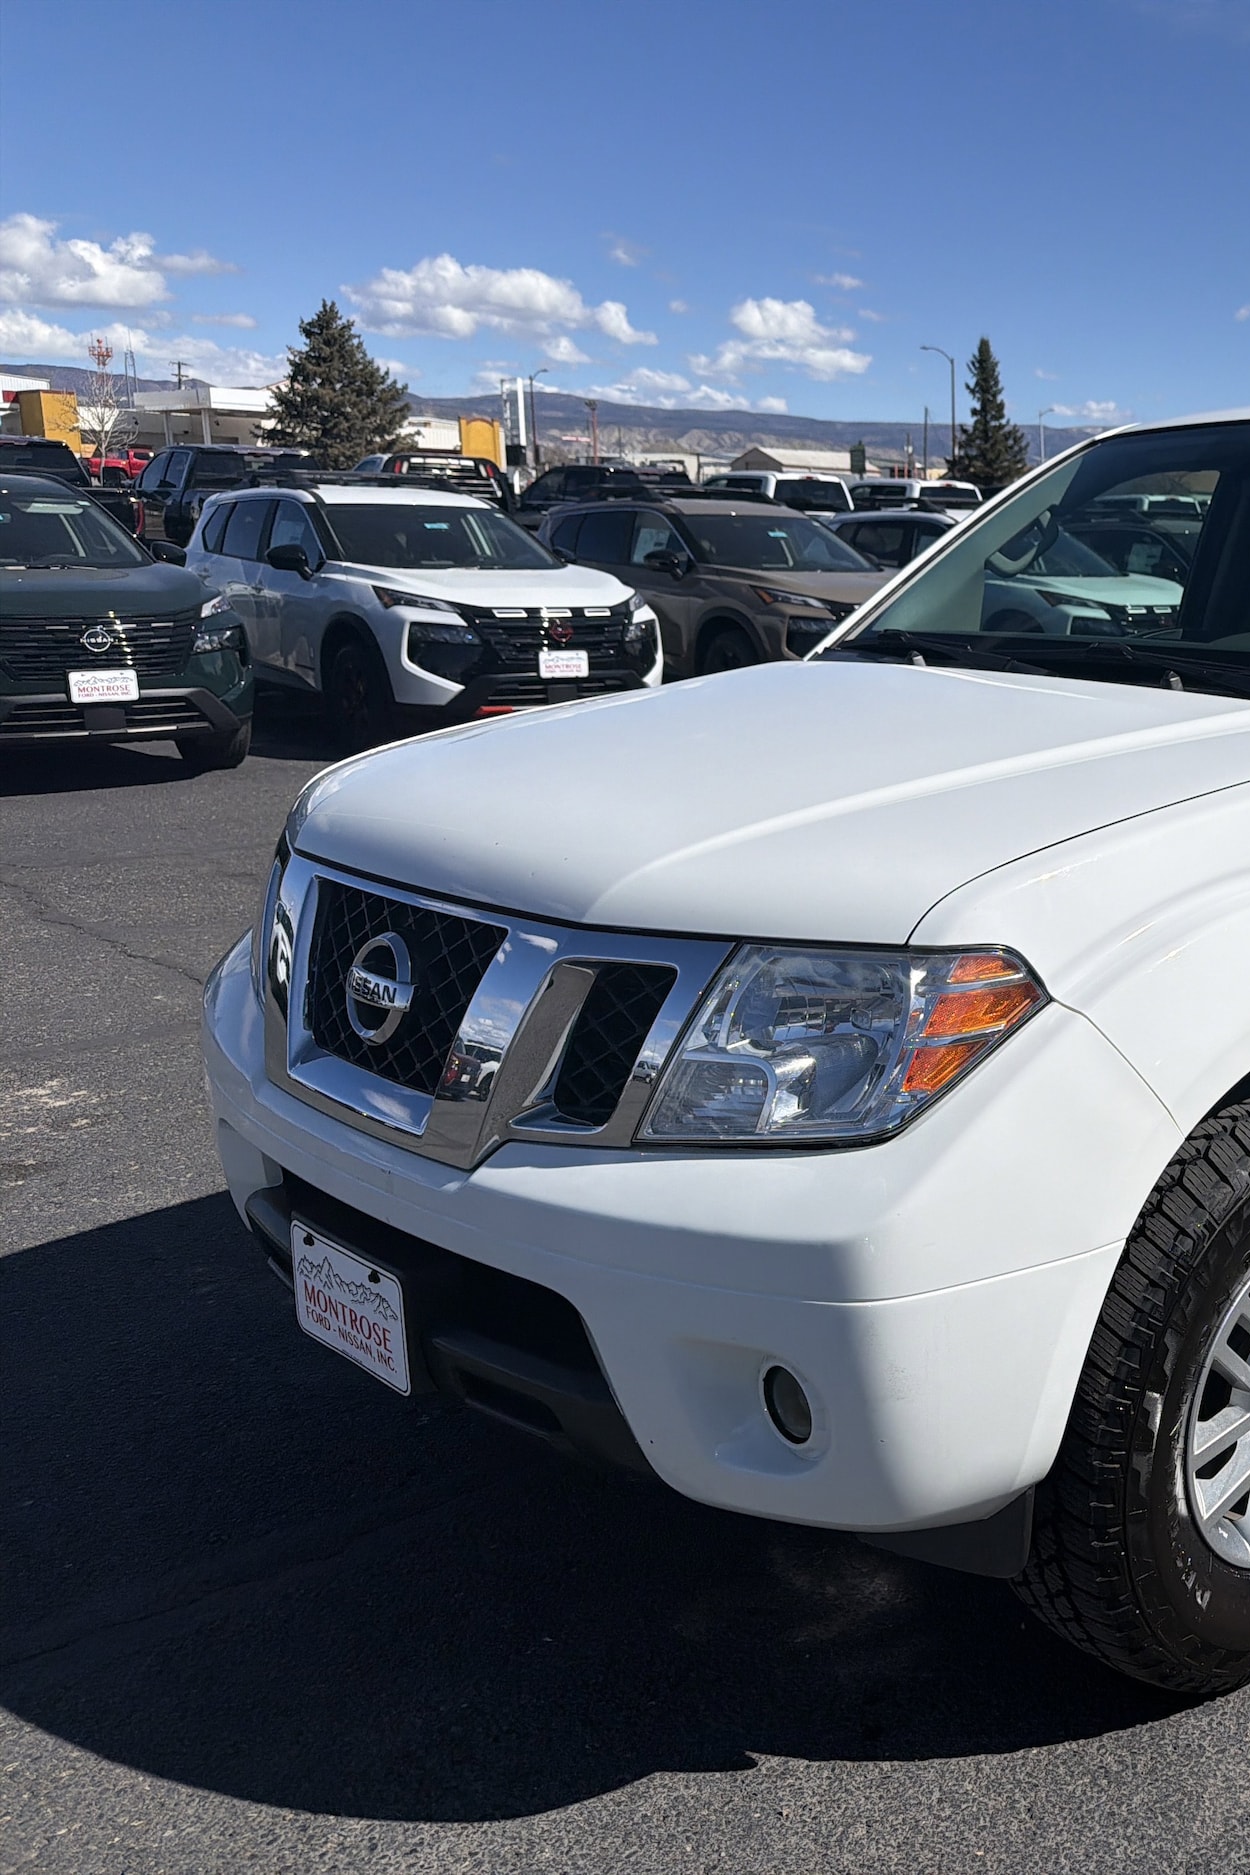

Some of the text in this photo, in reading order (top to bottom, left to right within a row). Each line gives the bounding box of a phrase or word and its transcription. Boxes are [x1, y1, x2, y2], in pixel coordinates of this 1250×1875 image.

[77, 684, 130, 693] MONTROSE
[304, 1280, 393, 1354] MONTROSE
[306, 1306, 331, 1331] FORD
[338, 1327, 376, 1363] NISSAN,
[376, 1350, 398, 1374] INC.
